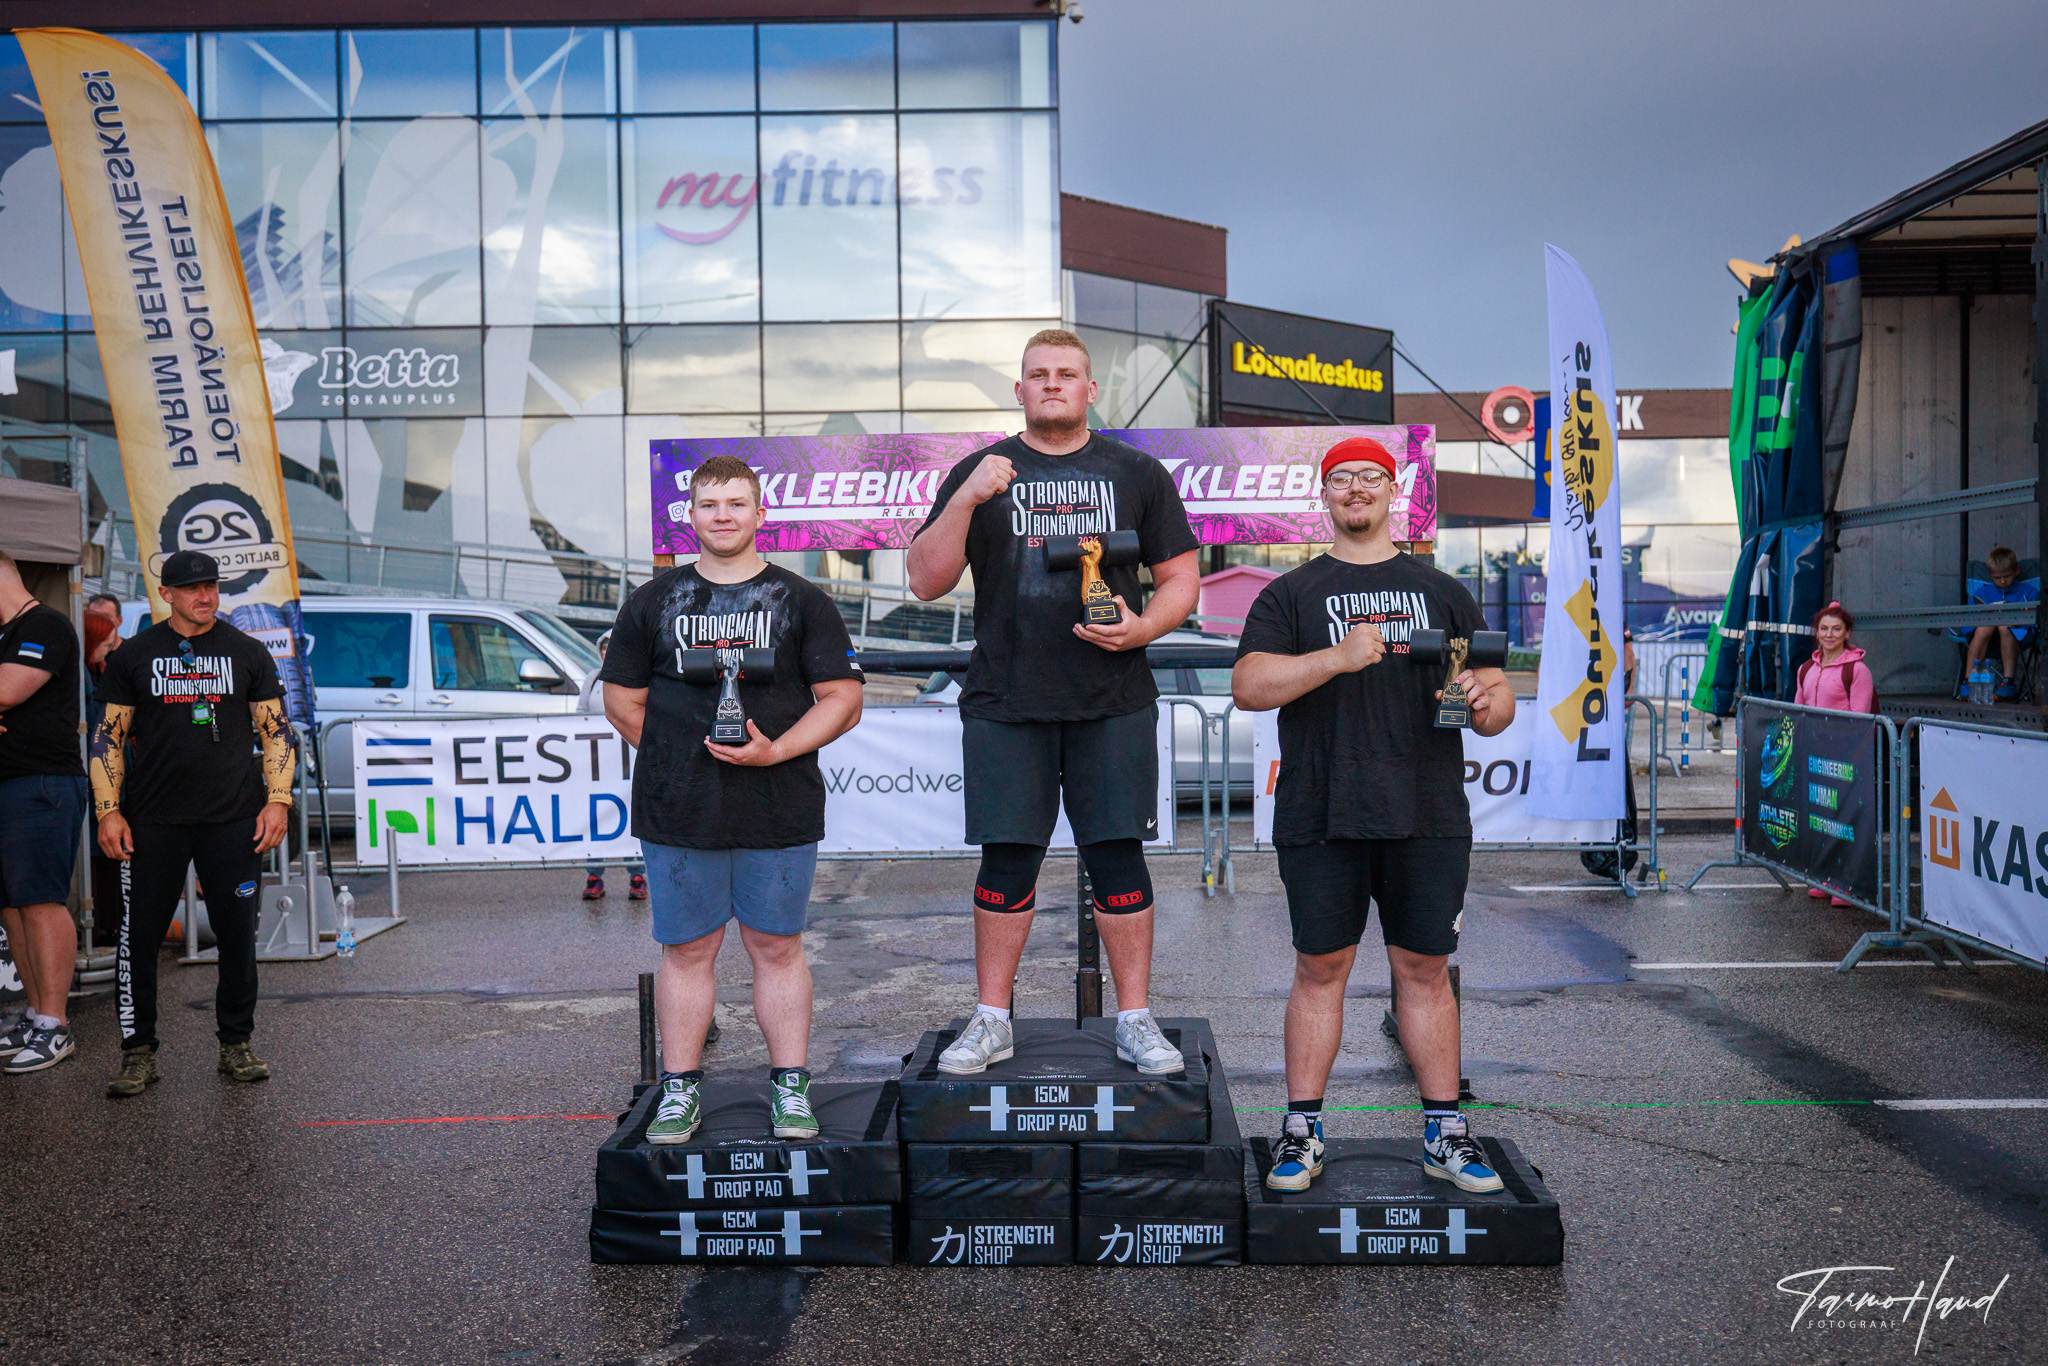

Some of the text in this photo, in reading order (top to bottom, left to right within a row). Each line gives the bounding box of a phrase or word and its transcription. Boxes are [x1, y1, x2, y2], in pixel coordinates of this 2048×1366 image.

[318, 347, 460, 389] Betta
[1232, 341, 1384, 393] Lõunakeskus
[321, 394, 457, 405] ZOOKAUPLUS
[757, 470, 951, 507] KLEEBIKU
[1179, 463, 1420, 499] KLEEBIM
[1012, 481, 1116, 514] STRONGMAN
[882, 507, 929, 518] REKL
[1055, 504, 1074, 514] PRO
[1012, 504, 1116, 536] STRONGWOMAN
[1326, 590, 1429, 624] STRONGMAN
[1369, 613, 1387, 623] PRO
[675, 610, 772, 648] STRONGMAN
[715, 639, 730, 650] PRO
[453, 732, 631, 785] EESTI
[1808, 755, 1855, 783] ENGINEERING
[1808, 782, 1839, 811] HUMAN
[1759, 803, 1796, 832] ATHLETE
[1766, 823, 1788, 841] BYTES
[1808, 813, 1855, 843] PERFORMANCE
[976, 886, 1003, 904] SBD
[1110, 891, 1141, 907] SBD
[118, 859, 136, 1040] RMLIFTING ESTONIA
[1034, 1085, 1069, 1103] 15CM
[1018, 1114, 1087, 1132] DROP PAD
[730, 1152, 764, 1171] 15CM
[714, 1179, 783, 1199] DROP PAD
[722, 1211, 757, 1229] 15CM
[1385, 1208, 1420, 1226] 15CM
[975, 1225, 1054, 1245] STRENGTH
[1143, 1224, 1224, 1244] STRENGTH
[706, 1238, 775, 1256] DROP PAD
[1143, 1245, 1182, 1264] SHOP
[1368, 1236, 1439, 1254] DROP PAD
[975, 1246, 1013, 1264] SHOP
